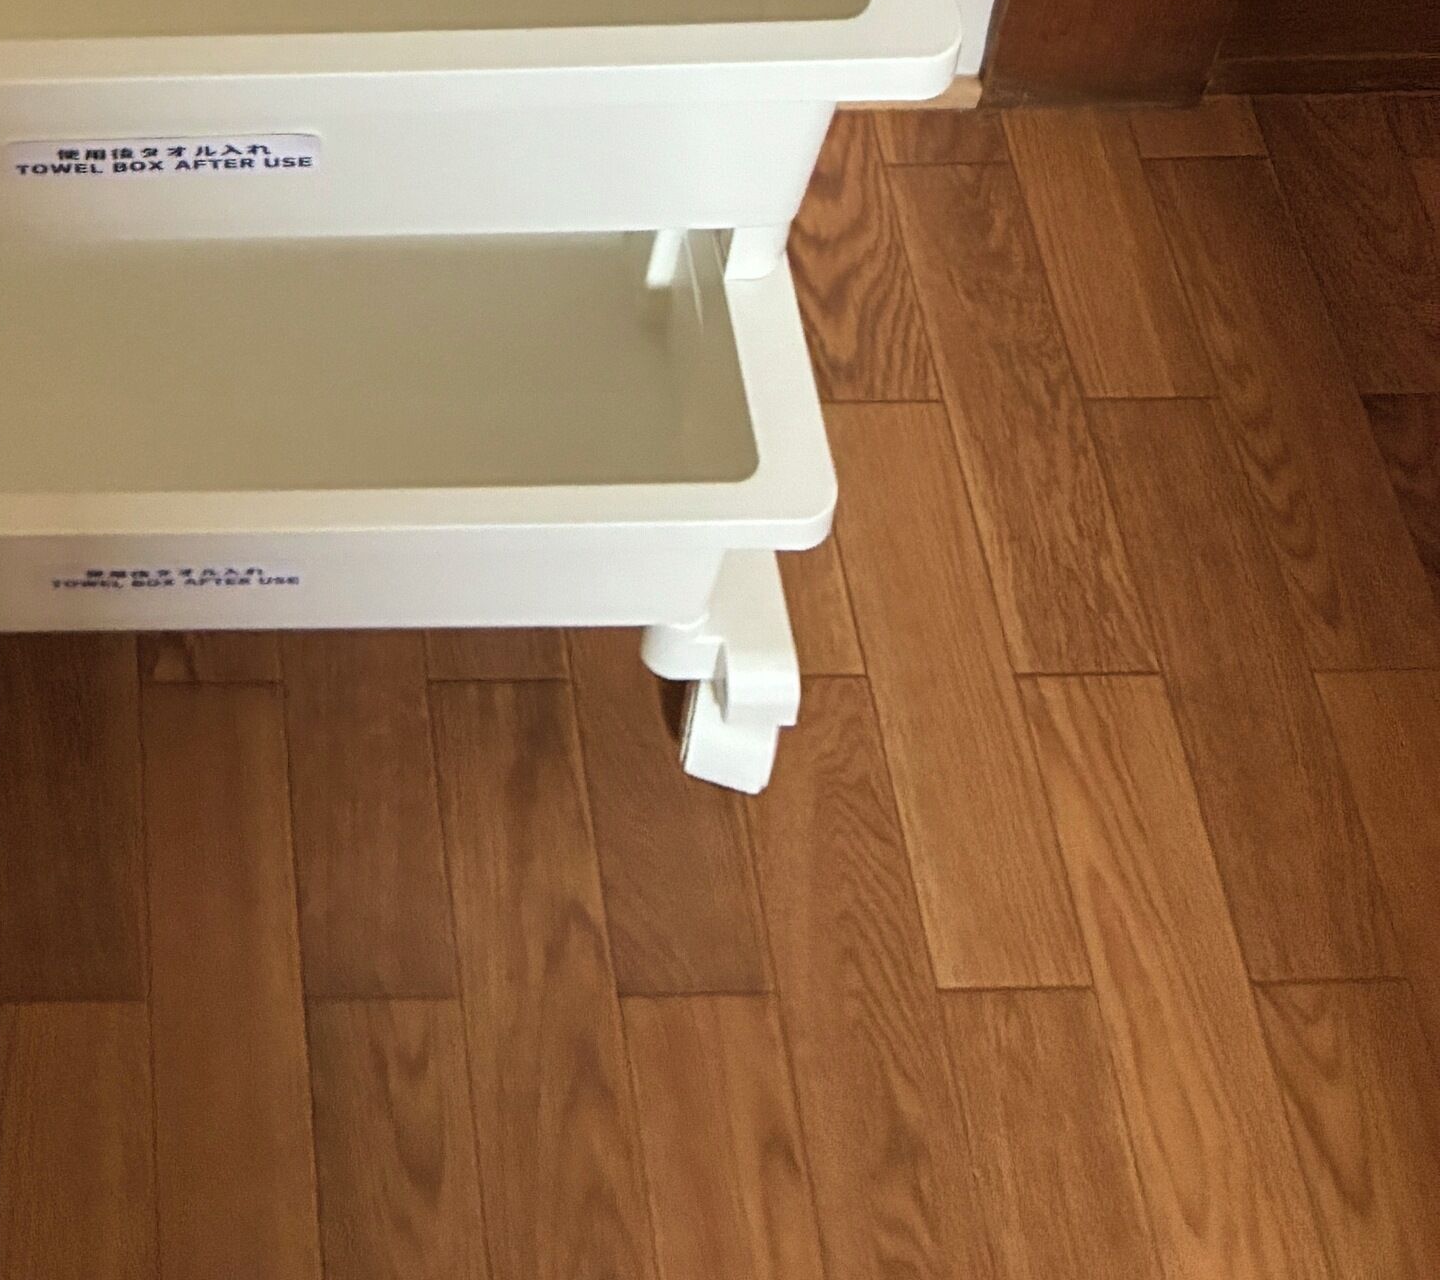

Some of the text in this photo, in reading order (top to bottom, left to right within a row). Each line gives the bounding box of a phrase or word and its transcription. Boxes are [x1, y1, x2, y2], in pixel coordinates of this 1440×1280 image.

[56, 144, 272, 160] 使用後タオル入れ
[15, 156, 312, 175] TOWEL BOX AFTER USE
